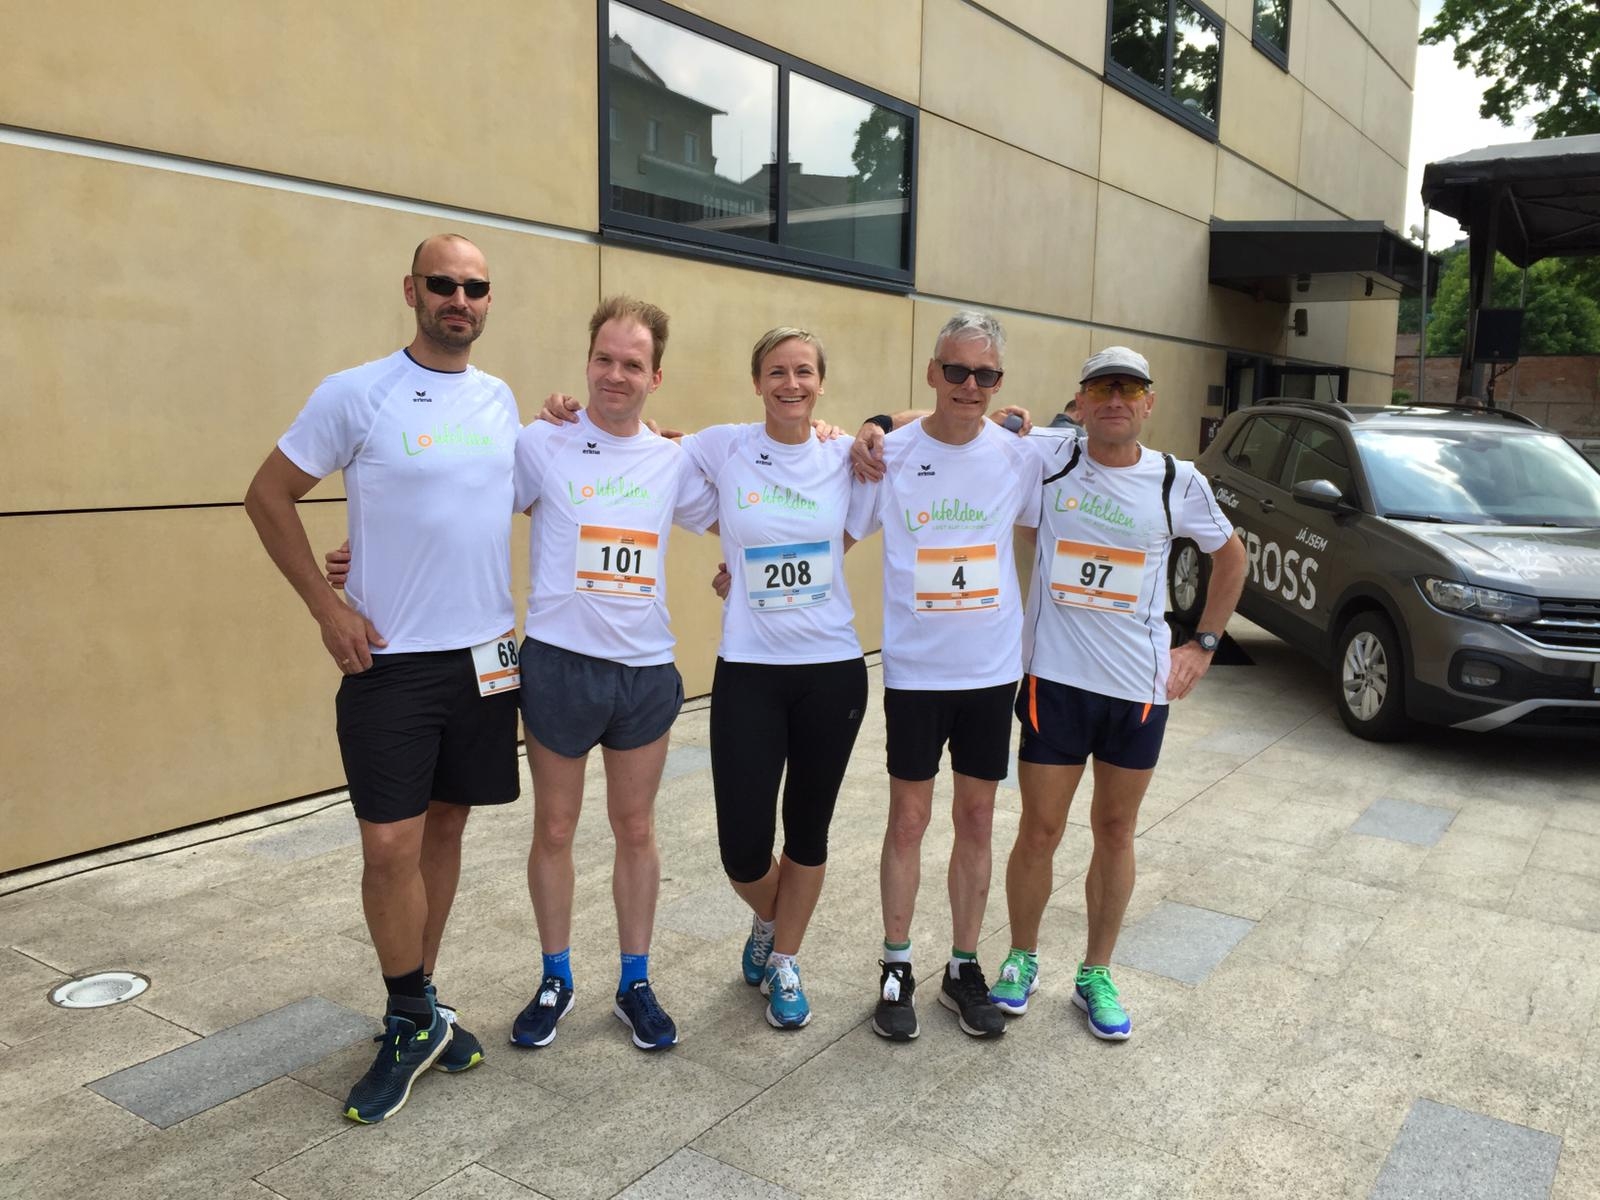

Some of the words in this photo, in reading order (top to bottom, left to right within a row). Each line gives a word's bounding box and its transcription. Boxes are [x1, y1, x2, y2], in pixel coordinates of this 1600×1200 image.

[736, 485, 817, 511] Lohfelden
[1054, 488, 1136, 528] Lohfelden
[905, 498, 987, 532] Lohfelden
[1295, 527, 1306, 543] JÁ
[1304, 532, 1328, 552] JSEM
[601, 546, 642, 574] 101
[764, 560, 812, 588] 208
[952, 566, 966, 589] 4
[1079, 562, 1113, 588] 97
[497, 640, 518, 668] 68
